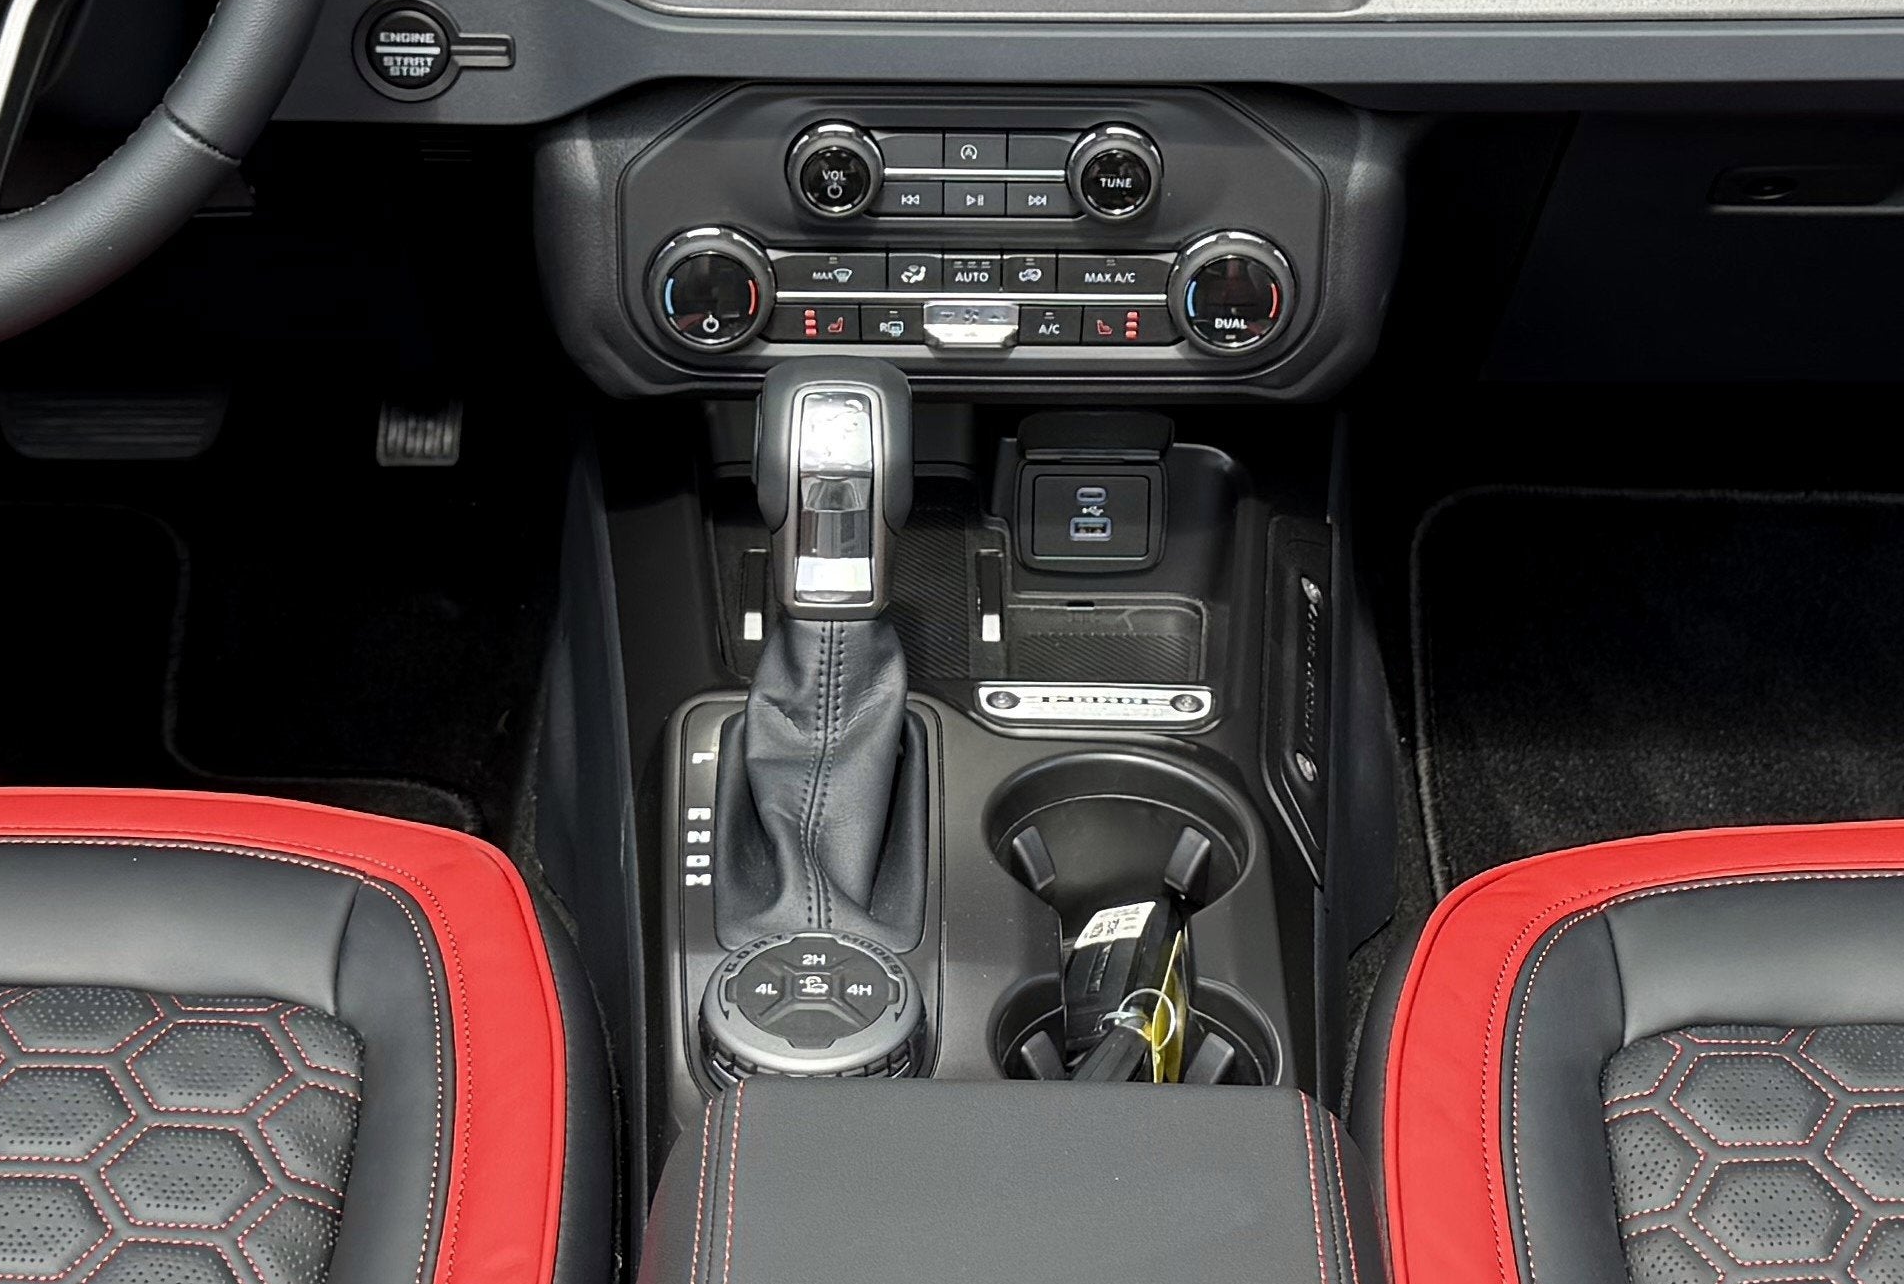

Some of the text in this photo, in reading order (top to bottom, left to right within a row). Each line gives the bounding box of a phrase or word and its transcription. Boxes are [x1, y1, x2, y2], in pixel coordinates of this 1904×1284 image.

[380, 32, 435, 44] ENGINE
[383, 56, 435, 66] START
[389, 66, 430, 77] STOP
[822, 170, 847, 181] VOL
[1099, 177, 1132, 188] TUNE
[812, 271, 833, 281] MAX
[955, 271, 990, 283] AUTO
[1085, 271, 1136, 284] MAX A/C
[1038, 323, 1061, 335] A/C
[1214, 317, 1248, 329] DUAL
[687, 830, 711, 843] N
[686, 854, 711, 868] D
[685, 873, 712, 886] M
[802, 953, 827, 965] 2H
[755, 983, 873, 996] 4L 4H
